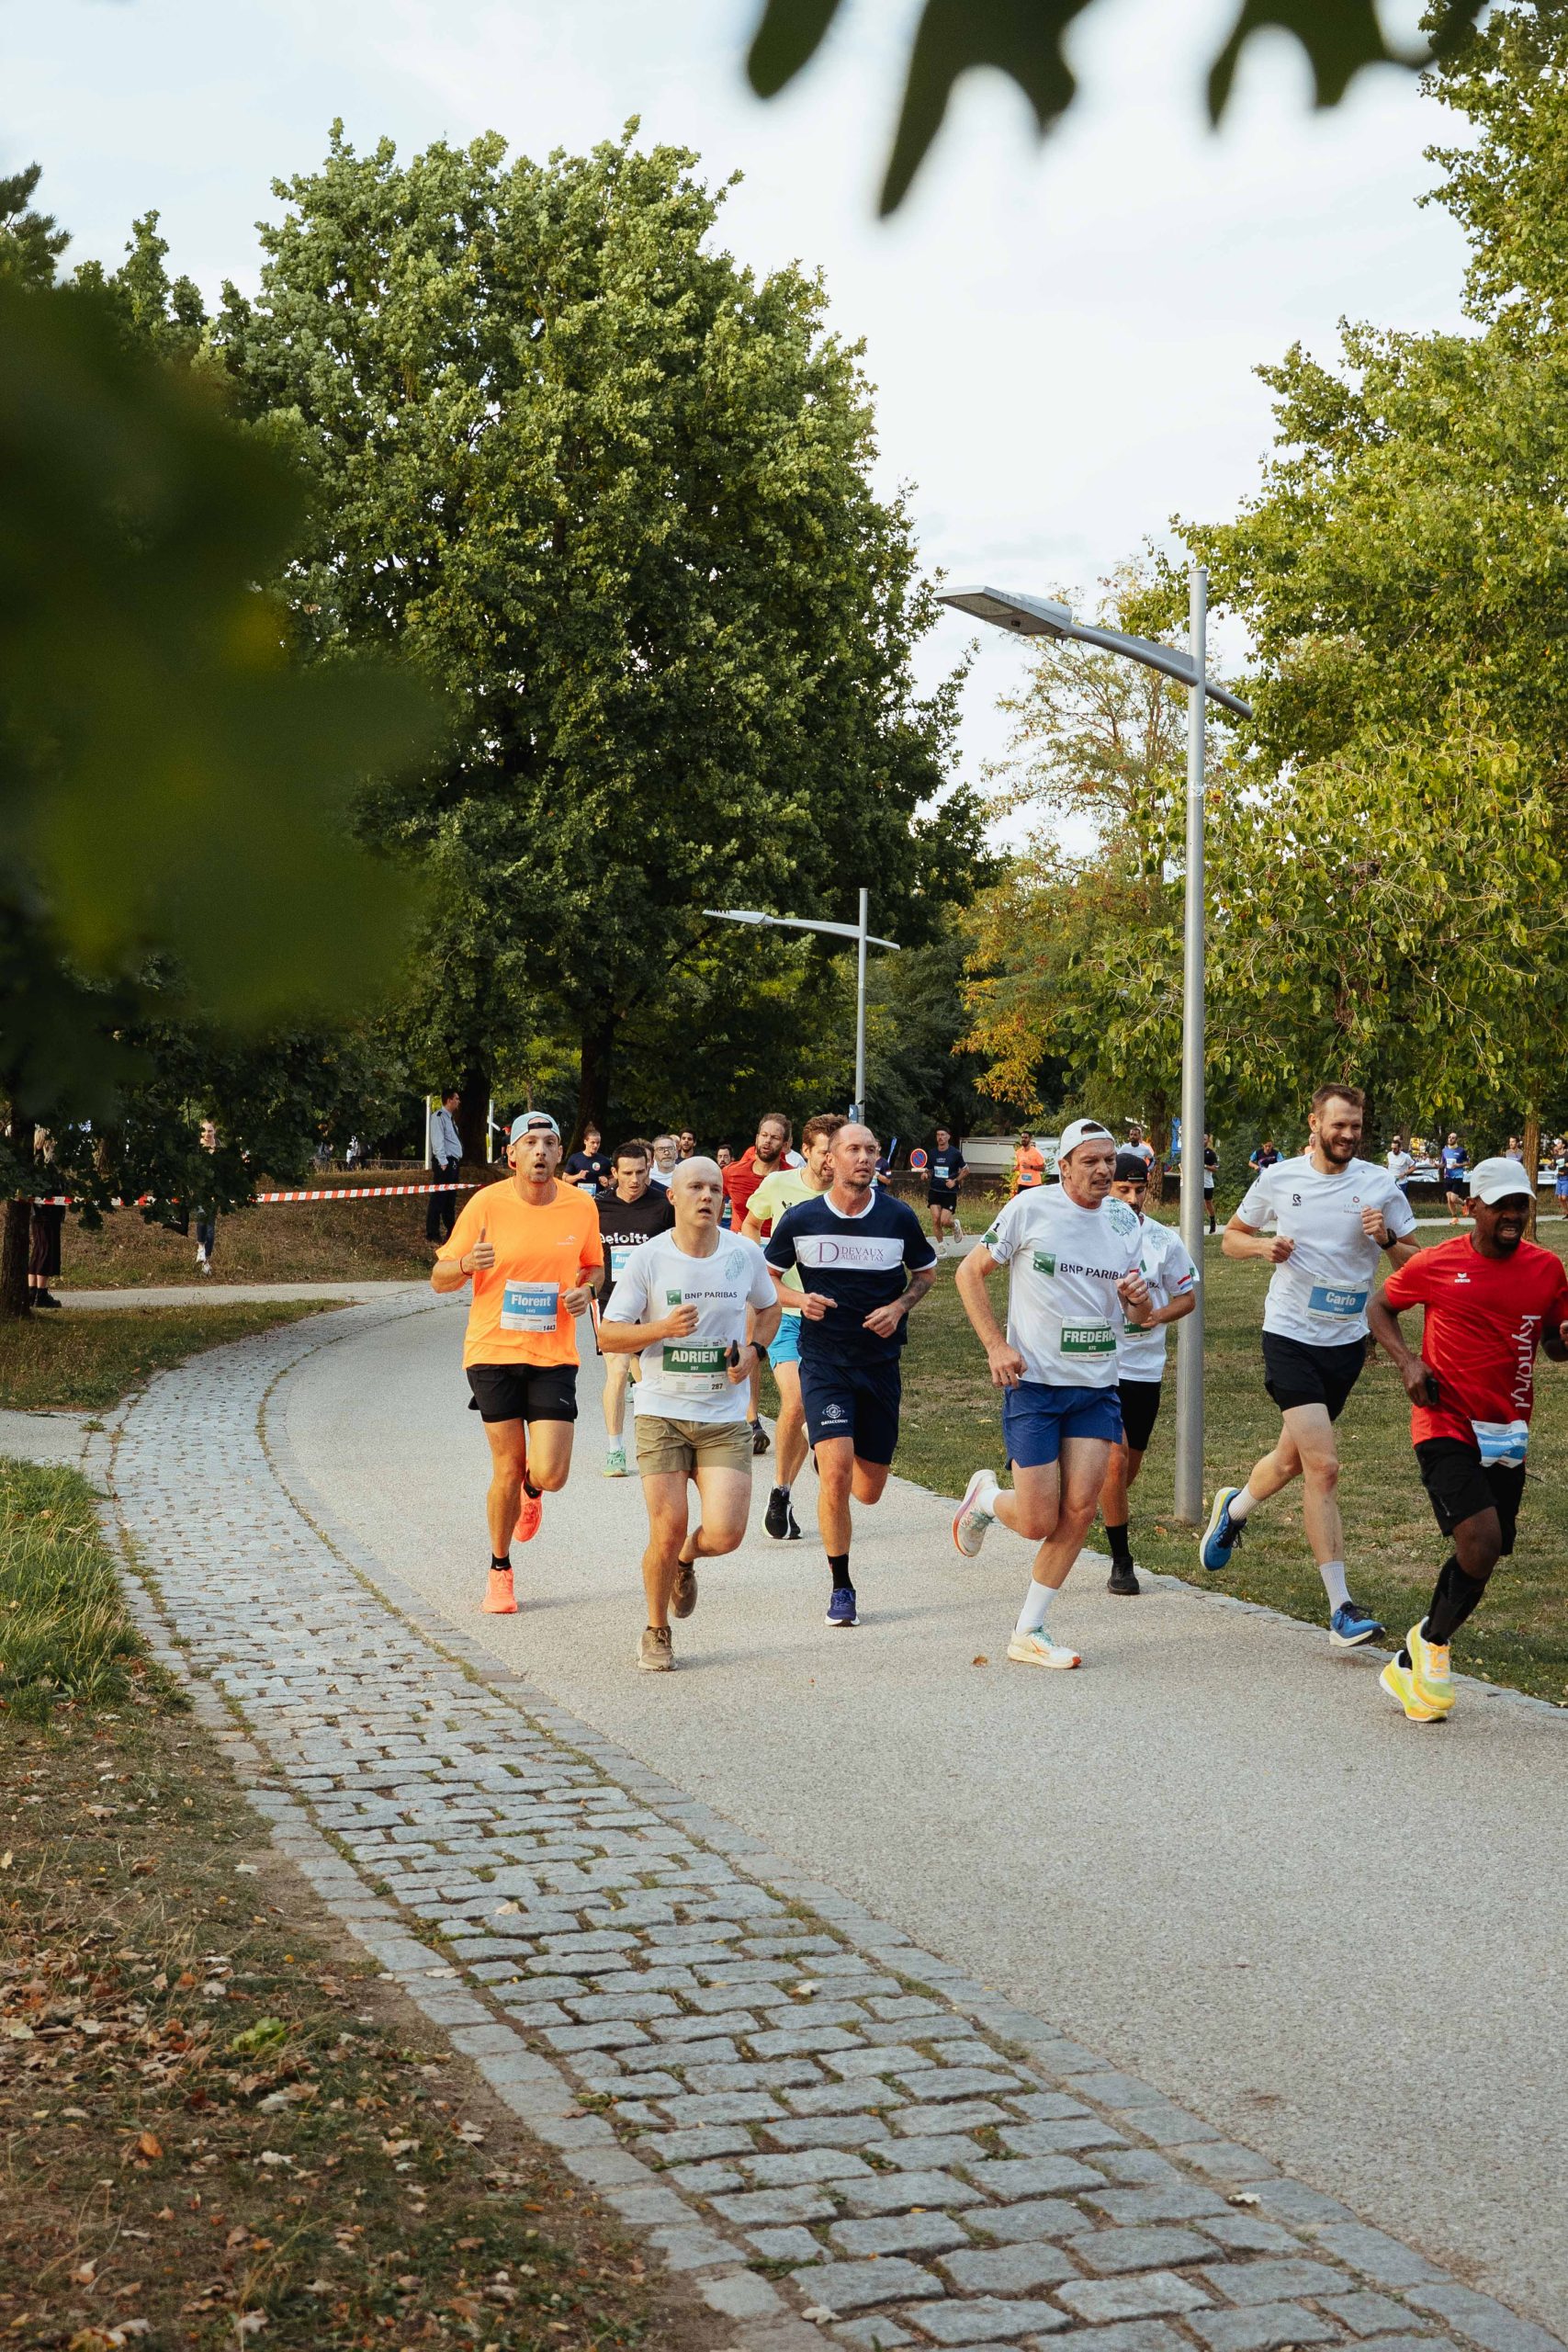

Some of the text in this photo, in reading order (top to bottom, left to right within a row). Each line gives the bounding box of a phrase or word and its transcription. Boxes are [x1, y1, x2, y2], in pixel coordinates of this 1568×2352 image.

[600, 1232, 649, 1244] Deloitt
[841, 1247, 884, 1257] DEVAUX
[1059, 1262, 1124, 1281] BNP PARIB
[511, 1294, 551, 1307] Florent
[684, 1292, 703, 1300] BNP
[1325, 1292, 1356, 1306] Carlo
[671, 1351, 718, 1363] ADRIEN
